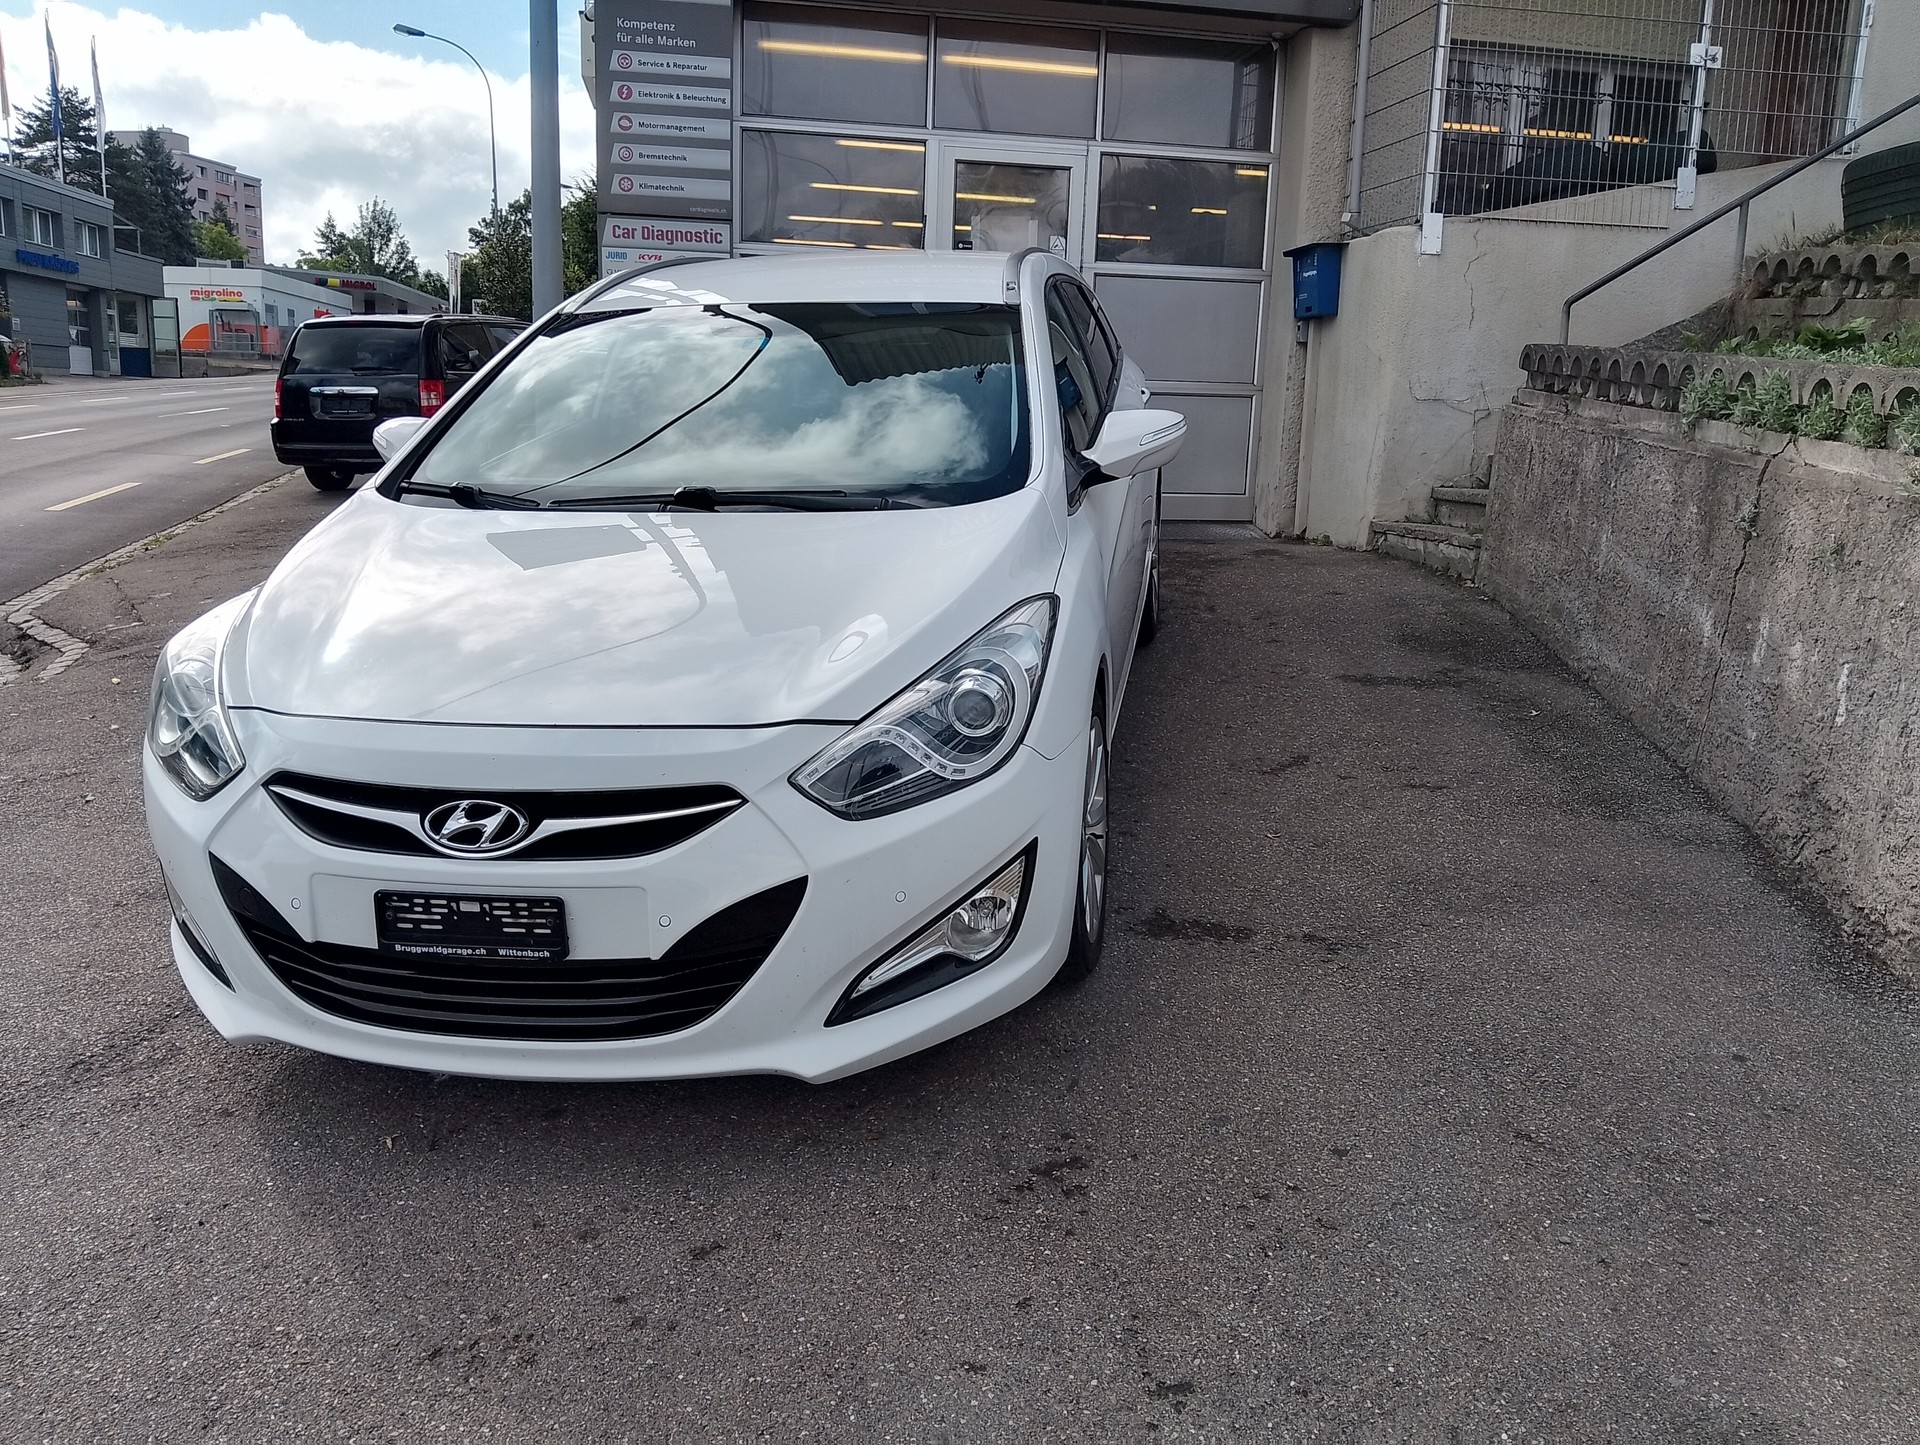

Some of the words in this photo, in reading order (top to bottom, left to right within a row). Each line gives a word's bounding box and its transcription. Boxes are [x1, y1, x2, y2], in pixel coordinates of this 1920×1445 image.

[616, 17, 676, 32] Kompetenz
[616, 31, 632, 44] für
[635, 33, 654, 45] alle
[657, 35, 696, 48] Marken
[637, 59, 664, 69] Service
[666, 61, 671, 69] &
[673, 62, 708, 72] Reparatur
[637, 90, 674, 101] Elektronik
[676, 93, 681, 101] &
[682, 93, 727, 105] Beleuchtung
[638, 121, 706, 133] Motormanagement
[638, 152, 688, 162] Bremstechnik
[638, 182, 685, 192] Klimatechnik
[612, 224, 638, 240] Car
[641, 225, 723, 245] Diagnostic
[605, 251, 628, 260] JURID
[341, 279, 377, 291] MIGROL
[190, 287, 243, 299] migrolino
[395, 944, 487, 956] Bruggwaldgarage.ch
[498, 948, 550, 958] Wittenbach
